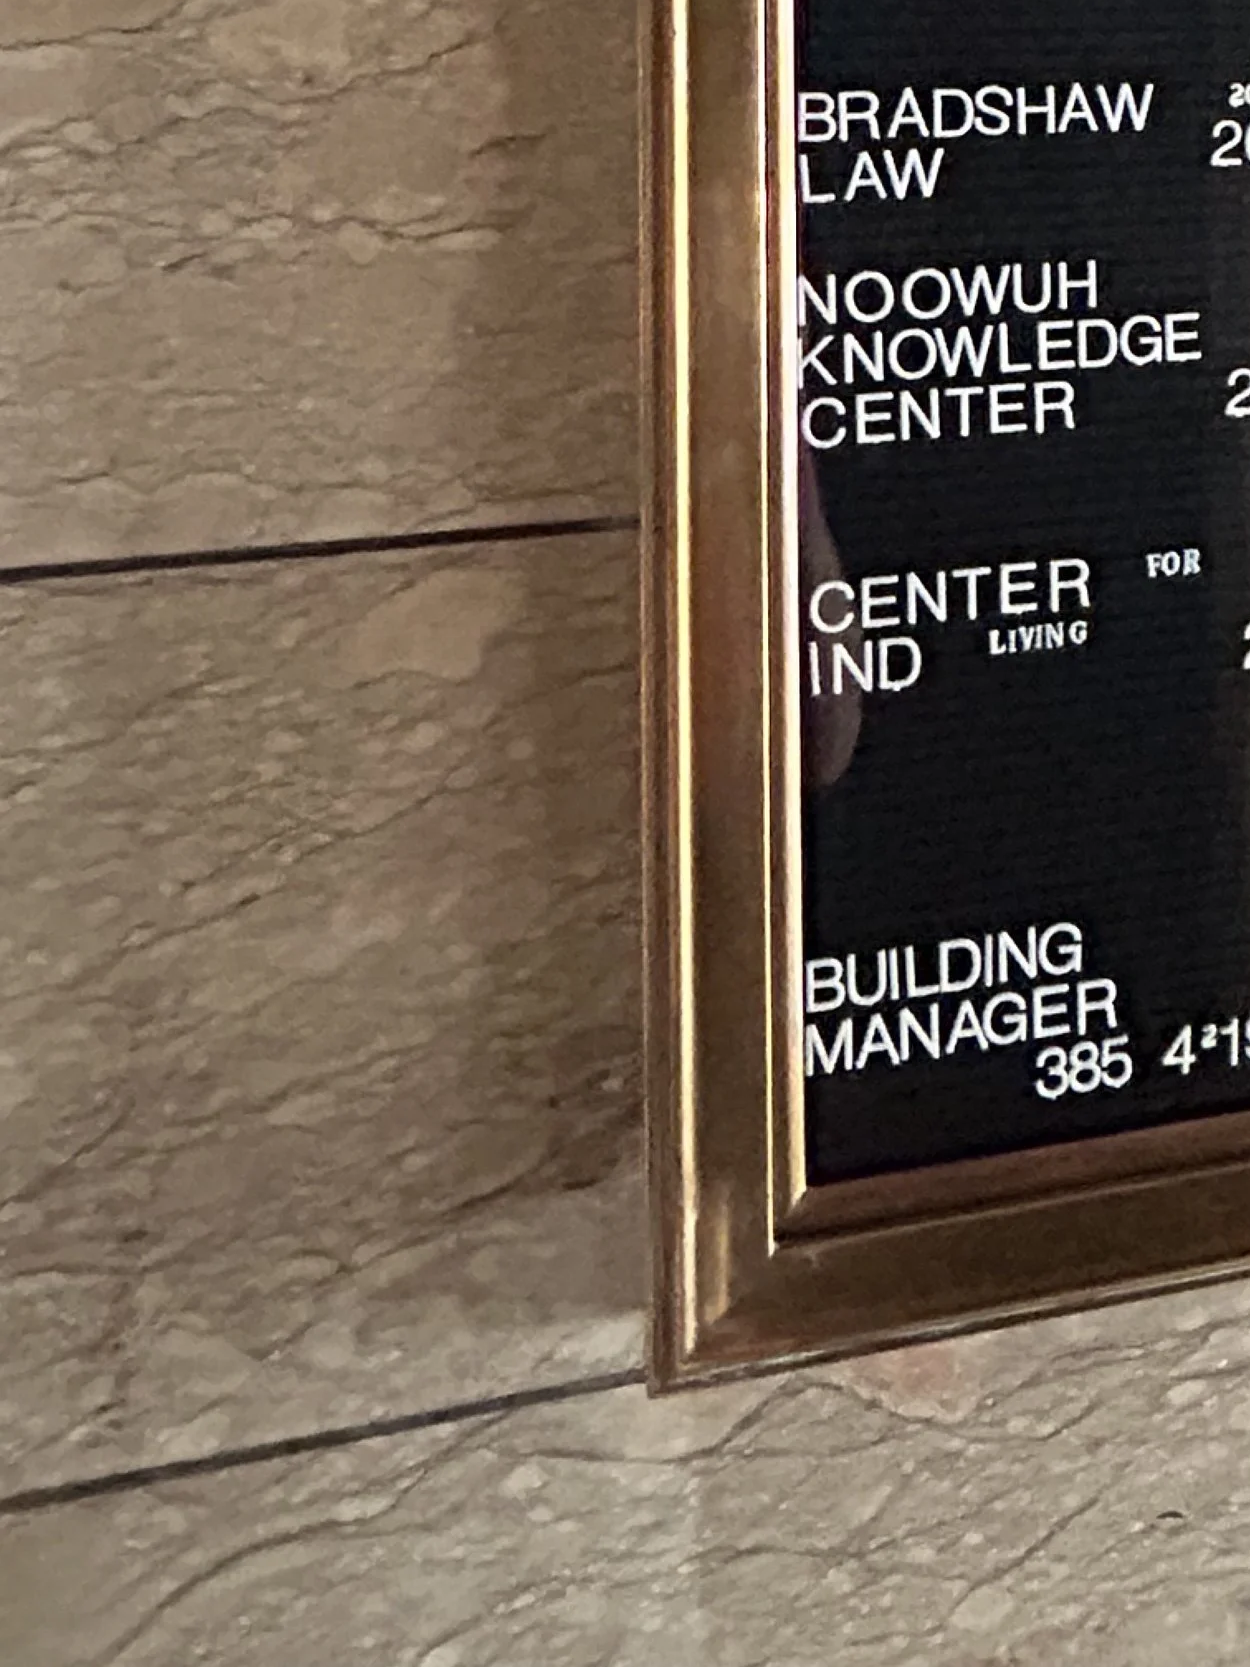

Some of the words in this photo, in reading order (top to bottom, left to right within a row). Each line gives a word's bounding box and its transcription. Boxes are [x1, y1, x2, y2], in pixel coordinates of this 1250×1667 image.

[798, 82, 1154, 143] BRADSHAW
[799, 148, 944, 203] LAW
[797, 259, 1098, 327] NOOWUH
[798, 312, 1201, 388] KNOWLEDGE
[802, 381, 1076, 449] CENTER
[809, 558, 1091, 634] CENTER
[1147, 548, 1200, 578] FOR
[809, 636, 921, 696] IND
[989, 620, 1088, 655] LIVING
[805, 922, 1083, 1013] BUILDING
[805, 977, 1117, 1077] MANAGER
[1035, 1035, 1133, 1100] 385
